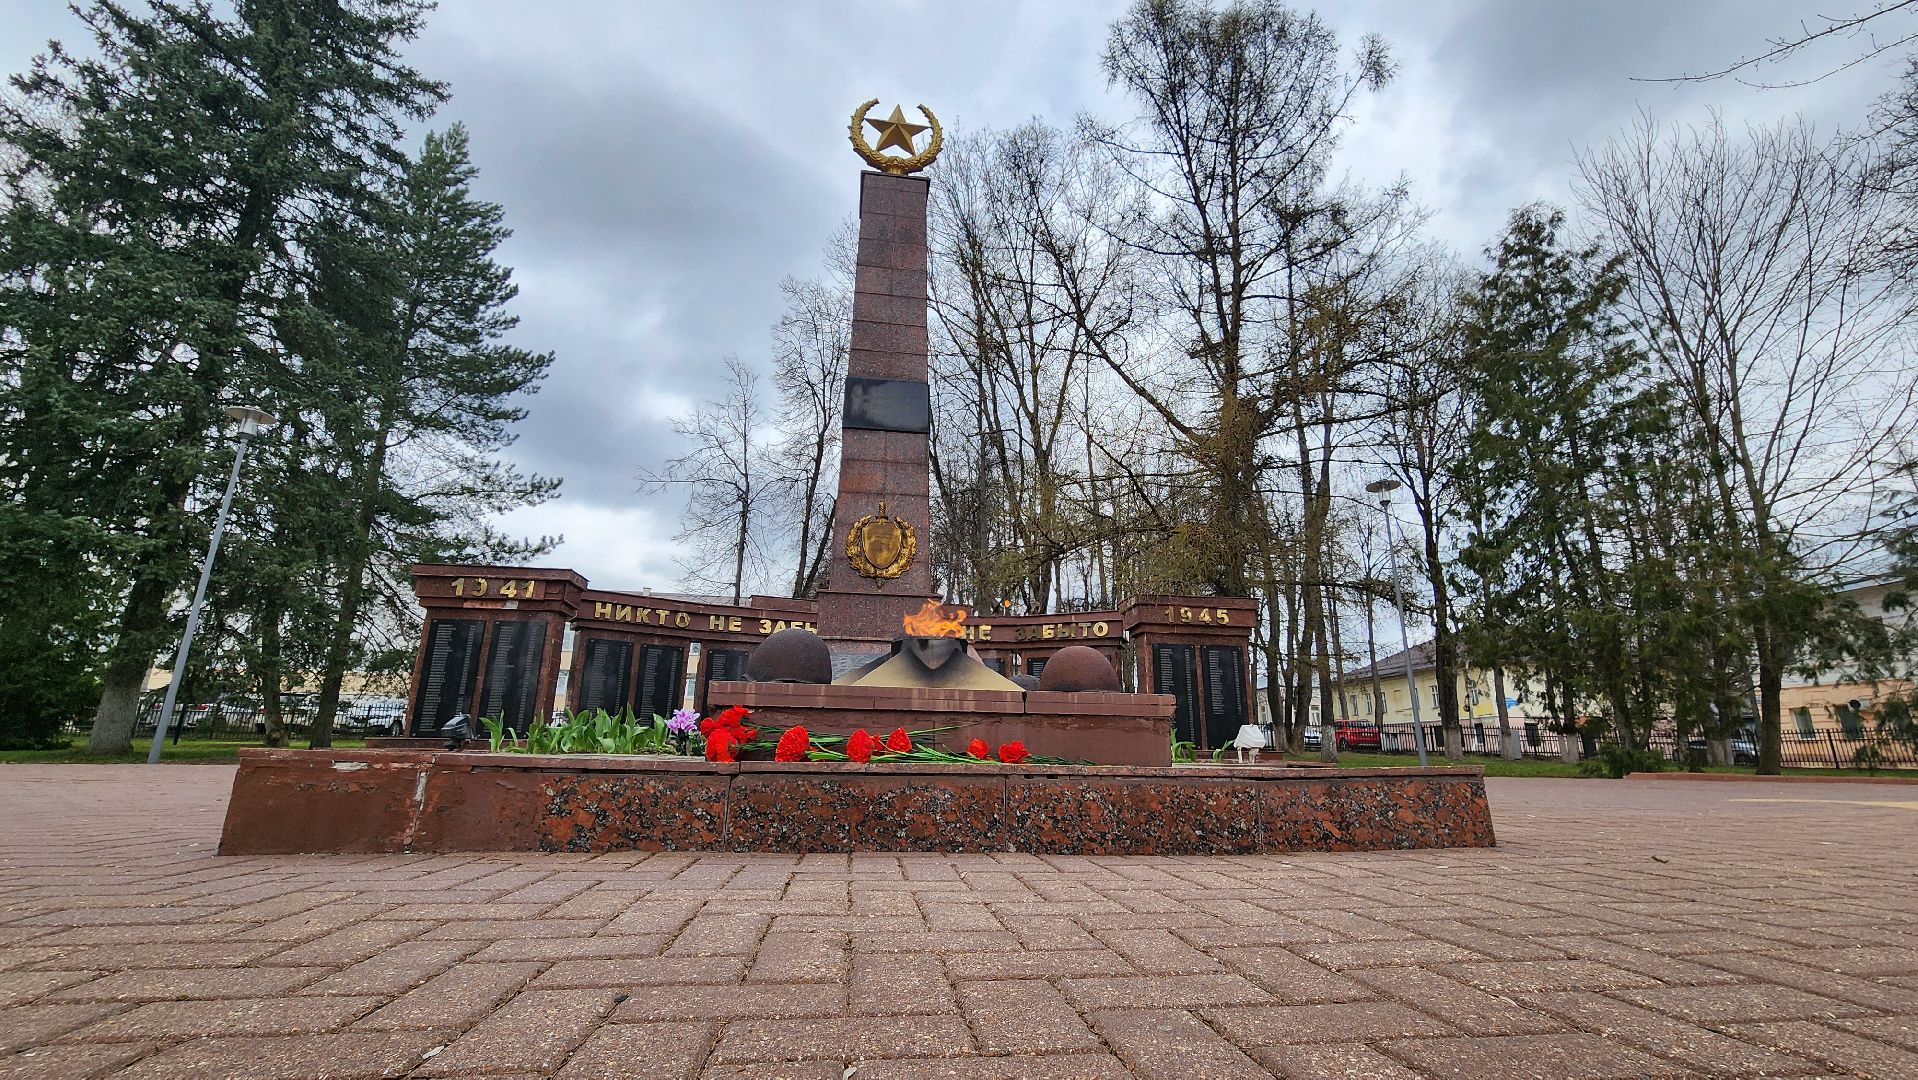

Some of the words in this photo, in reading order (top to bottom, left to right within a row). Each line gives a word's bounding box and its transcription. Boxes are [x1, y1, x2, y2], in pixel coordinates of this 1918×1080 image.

[451, 578, 535, 598] 1941
[594, 602, 691, 628] НИКТО
[709, 615, 742, 632] НЕ
[1165, 606, 1230, 625] 1945
[1016, 621, 1109, 640] ЗАБЫТО
